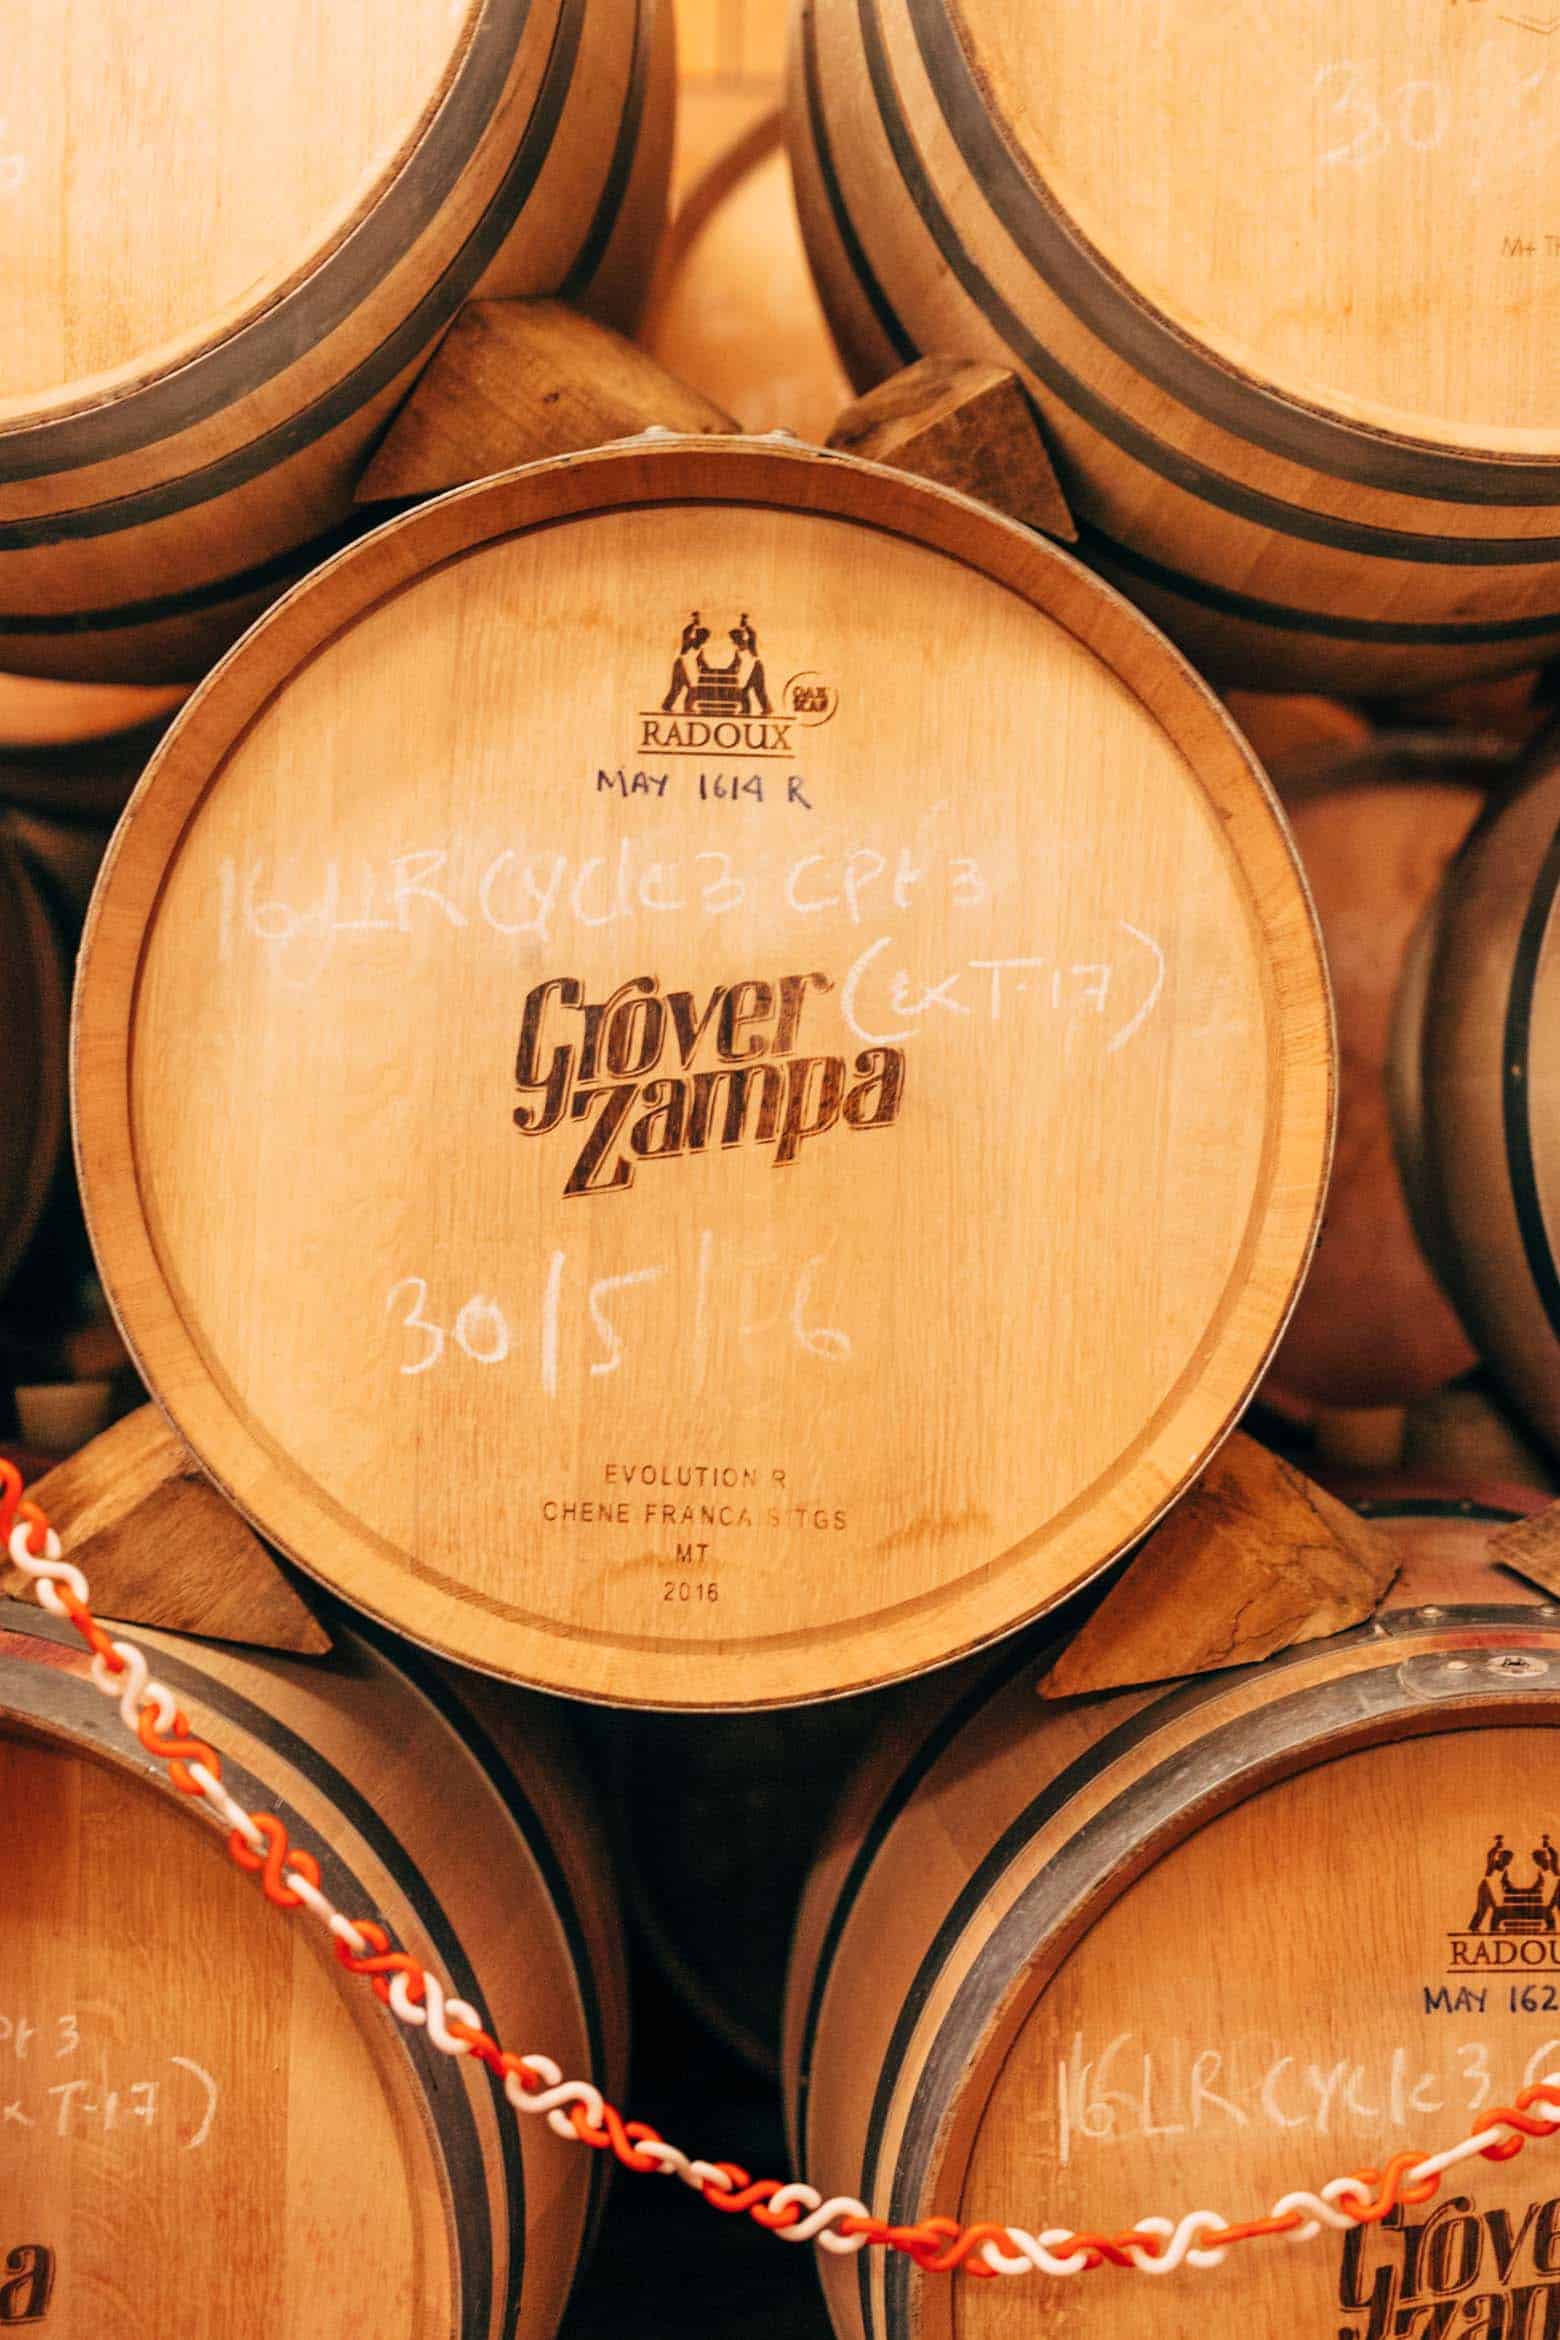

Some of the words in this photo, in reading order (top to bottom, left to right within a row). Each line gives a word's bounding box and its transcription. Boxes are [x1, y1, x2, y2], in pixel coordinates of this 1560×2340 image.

[640, 720, 793, 750] RADOUX
[597, 768, 668, 797] MAY
[700, 773, 763, 802] 1614
[788, 775, 812, 809] R
[512, 972, 836, 1137] Grover
[562, 1046, 906, 1199] Zampa
[604, 1463, 756, 1488] EVOLUTION
[771, 1468, 787, 1489] R
[543, 1501, 630, 1523] CHENE
[645, 1503, 780, 1528] FRANCAS
[795, 1507, 848, 1531] TGS
[675, 1543, 708, 1563] MT
[663, 1582, 719, 1602] 2016
[1423, 1985, 1488, 2015] MAY
[57, 2014, 81, 2058] 3
